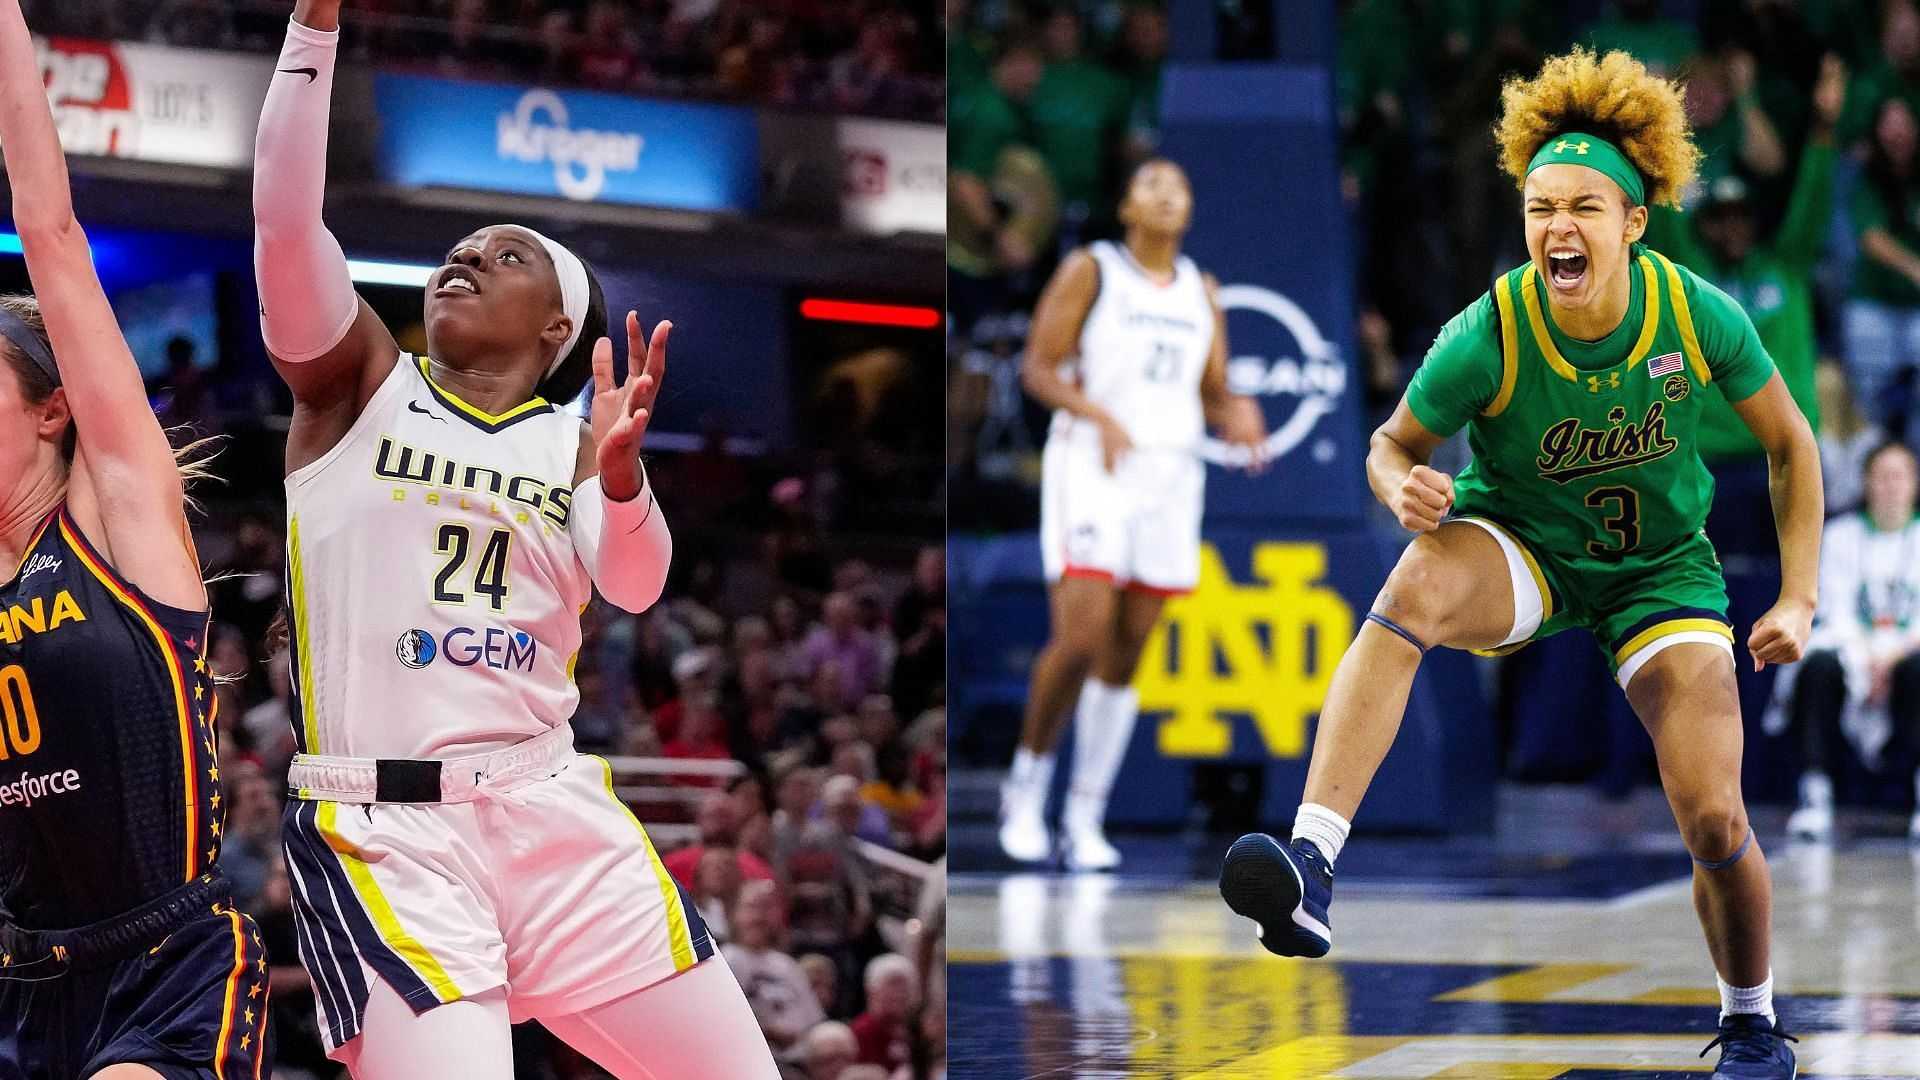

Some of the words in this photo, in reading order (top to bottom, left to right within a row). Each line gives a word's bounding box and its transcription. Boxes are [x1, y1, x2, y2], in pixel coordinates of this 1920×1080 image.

[498, 88, 645, 200] Kroger
[1536, 401, 1678, 485] Irish
[1584, 485, 1640, 555] 3
[20, 553, 63, 582] Lilly
[431, 520, 515, 615] 24
[0, 589, 88, 643] ANA
[442, 626, 537, 673] GEM
[0, 768, 81, 808] esforce
